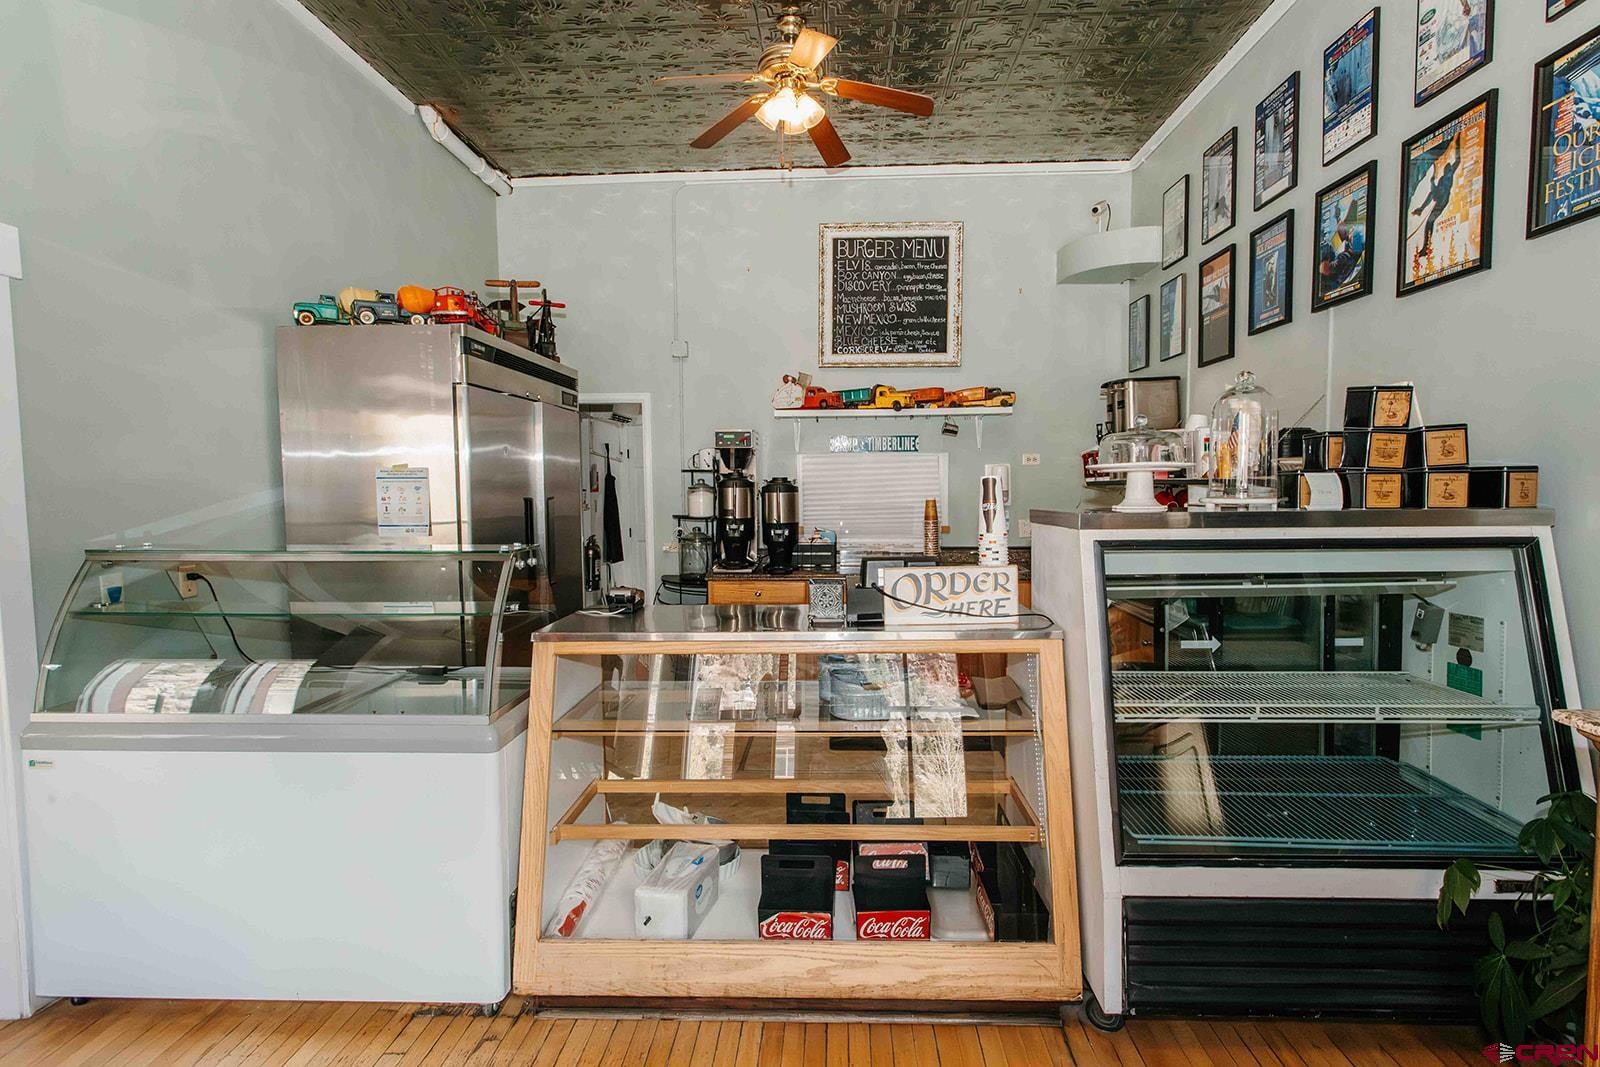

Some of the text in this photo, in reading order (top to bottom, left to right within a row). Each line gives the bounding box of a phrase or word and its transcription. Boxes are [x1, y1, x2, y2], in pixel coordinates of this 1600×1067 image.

[1545, 165, 1600, 204] FESTI
[836, 238, 945, 259] BURGER MENU
[861, 271, 897, 280] CANYON
[837, 281, 892, 292] DISCOVERY
[837, 303, 886, 315] MUSHROOM
[836, 313, 897, 325] NEW MEXICO
[835, 337, 860, 348] BLUE
[861, 335, 898, 346] CHEESE
[867, 436, 916, 452] TIMBERLINE
[891, 572, 1011, 610] ORDER
[945, 598, 1011, 617] HERE
[859, 917, 926, 939] Coca-Cola
